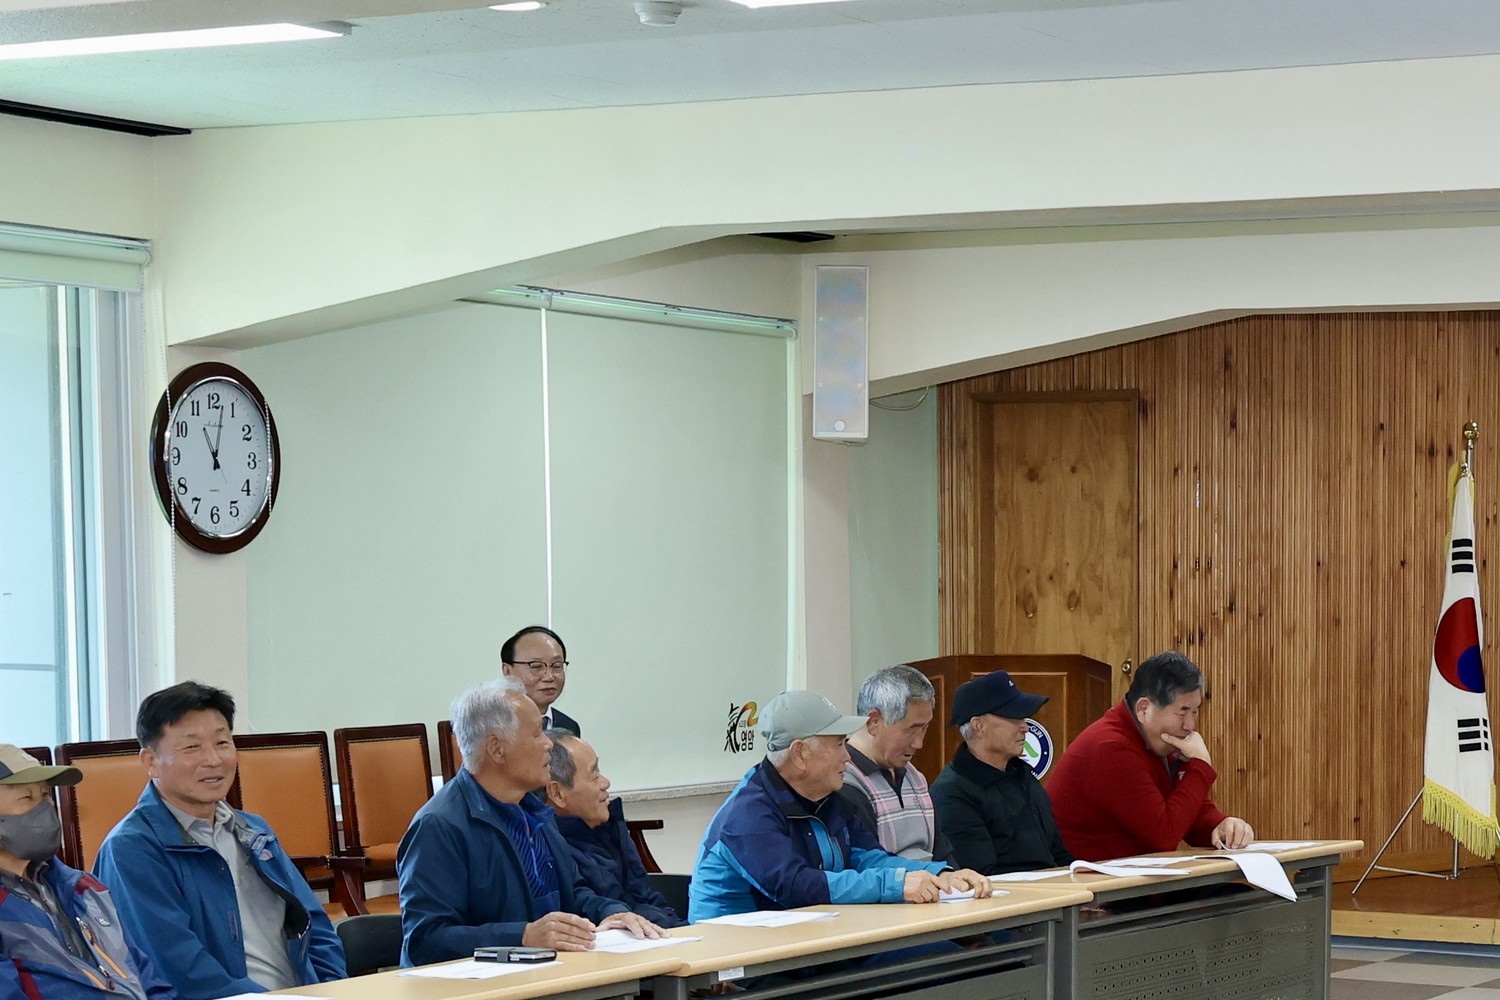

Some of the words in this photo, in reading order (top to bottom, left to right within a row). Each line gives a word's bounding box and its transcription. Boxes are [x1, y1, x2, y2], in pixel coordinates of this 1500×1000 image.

[191, 400, 200, 417] 11
[207, 393, 221, 410] 12
[230, 402, 235, 418] 1
[175, 421, 188, 438] 10
[242, 424, 252, 441] 2
[172, 447, 181, 465] 9
[247, 452, 257, 470] 3
[177, 477, 188, 495] 8
[241, 479, 251, 496] 4
[191, 497, 202, 515] 7
[229, 500, 240, 518] 5
[210, 506, 220, 524] 6
